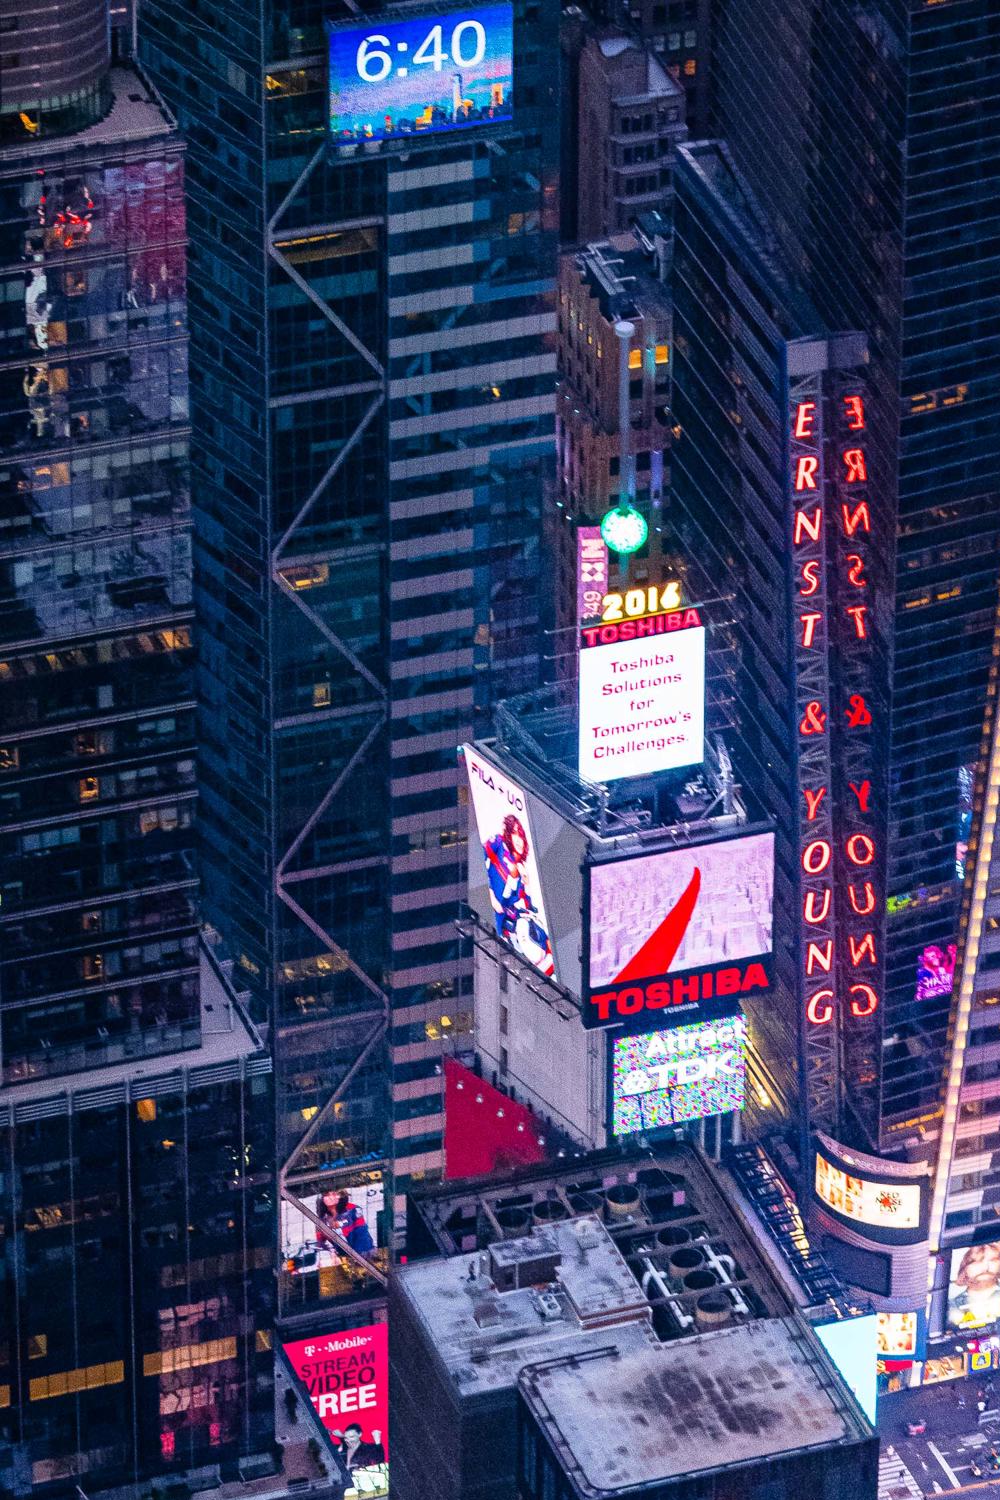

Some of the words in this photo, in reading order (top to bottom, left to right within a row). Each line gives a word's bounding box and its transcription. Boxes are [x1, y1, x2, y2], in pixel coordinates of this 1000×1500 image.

[357, 20, 487, 83] 6:40
[795, 401, 822, 647] ERNST
[602, 581, 681, 621] 2016
[582, 607, 702, 646] TOSHIBA
[611, 654, 674, 673] Toshiba
[602, 673, 682, 696] Solutions
[630, 699, 655, 711] for
[800, 701, 826, 734] &
[592, 711, 692, 739] Tomorrow's
[471, 761, 495, 791] FILA
[506, 790, 523, 812] UO
[802, 786, 833, 1024] YOUNG
[591, 963, 769, 1020] TOSHIBA
[648, 1050, 739, 1089] TDK
[301, 1351, 375, 1378] STREAM
